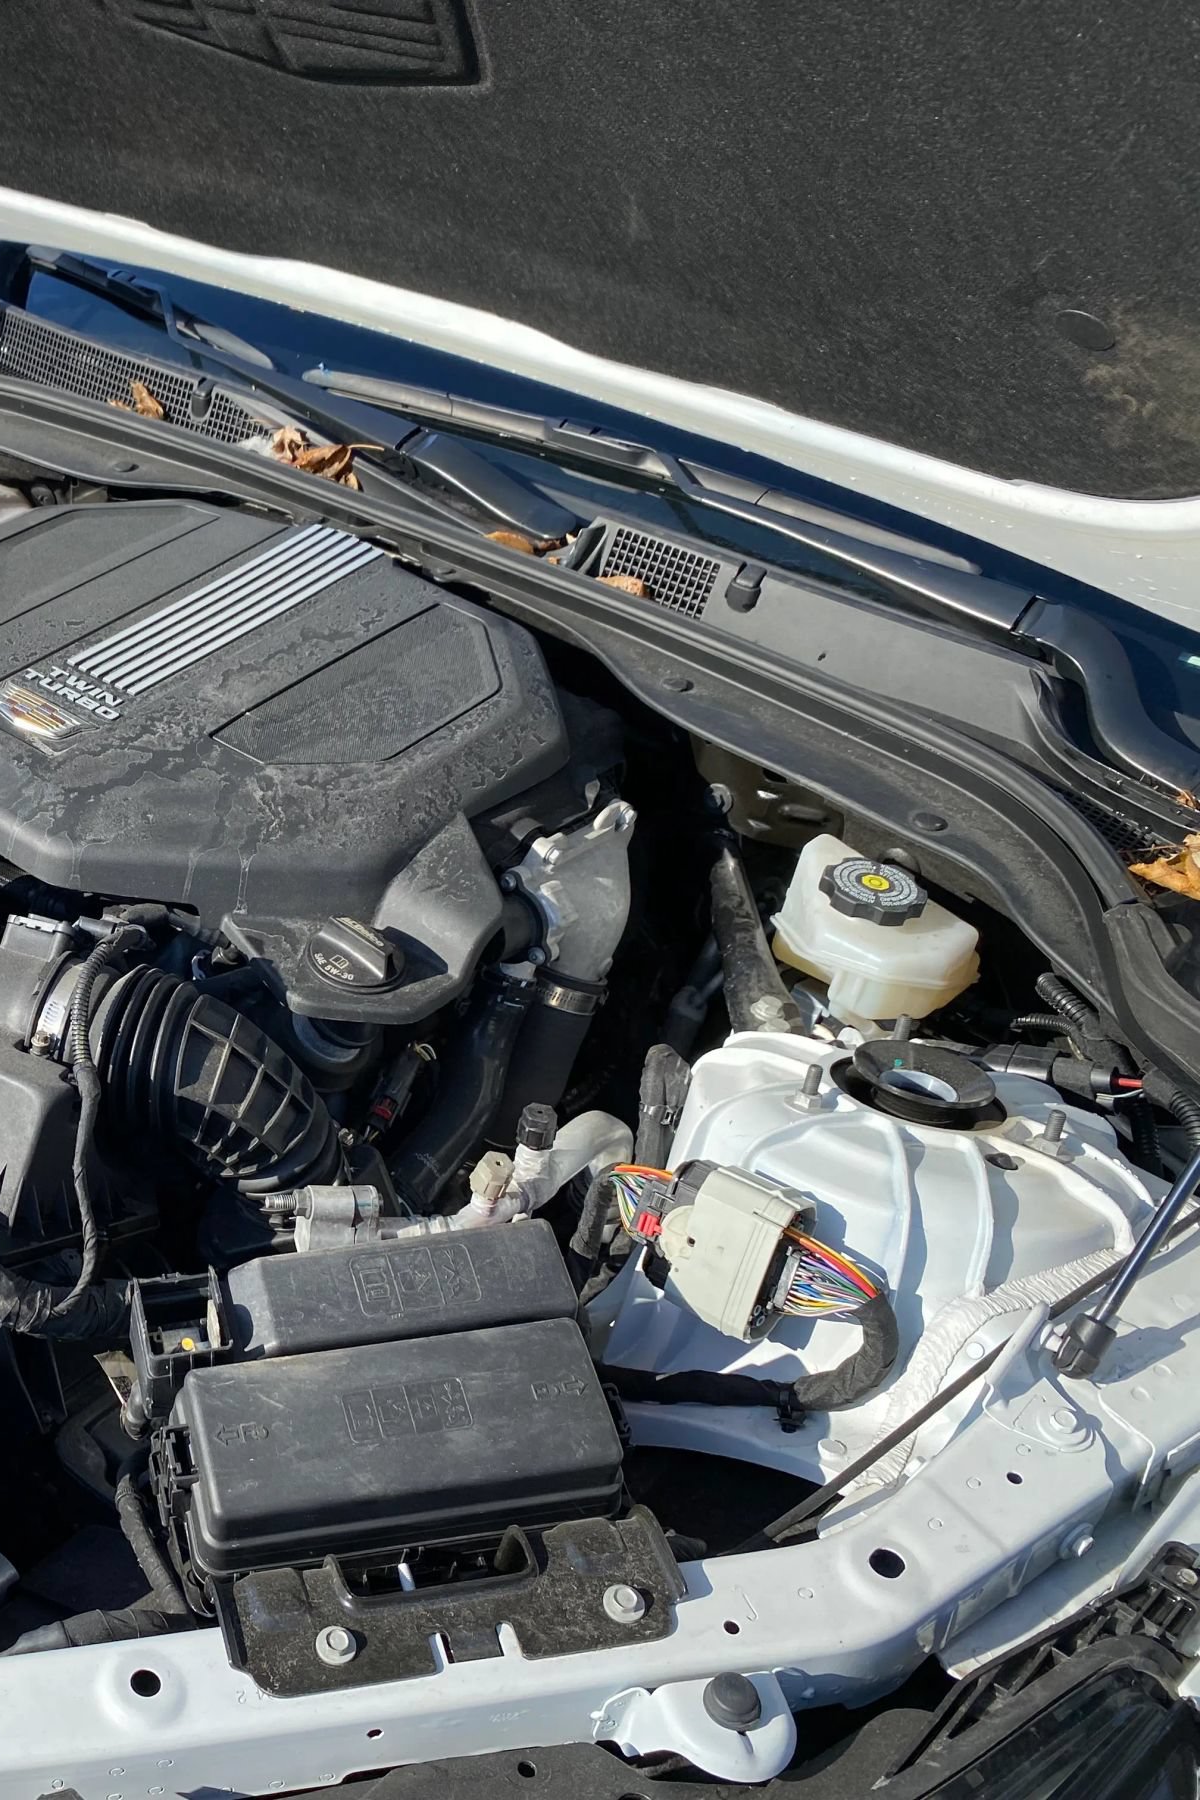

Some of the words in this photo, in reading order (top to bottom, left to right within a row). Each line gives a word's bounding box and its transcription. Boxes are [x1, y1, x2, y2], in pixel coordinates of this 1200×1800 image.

[24, 668, 122, 720] TURBO
[51, 666, 124, 707] TWIN
[314, 952, 327, 966] SAE
[324, 965, 354, 981] 5W-30
